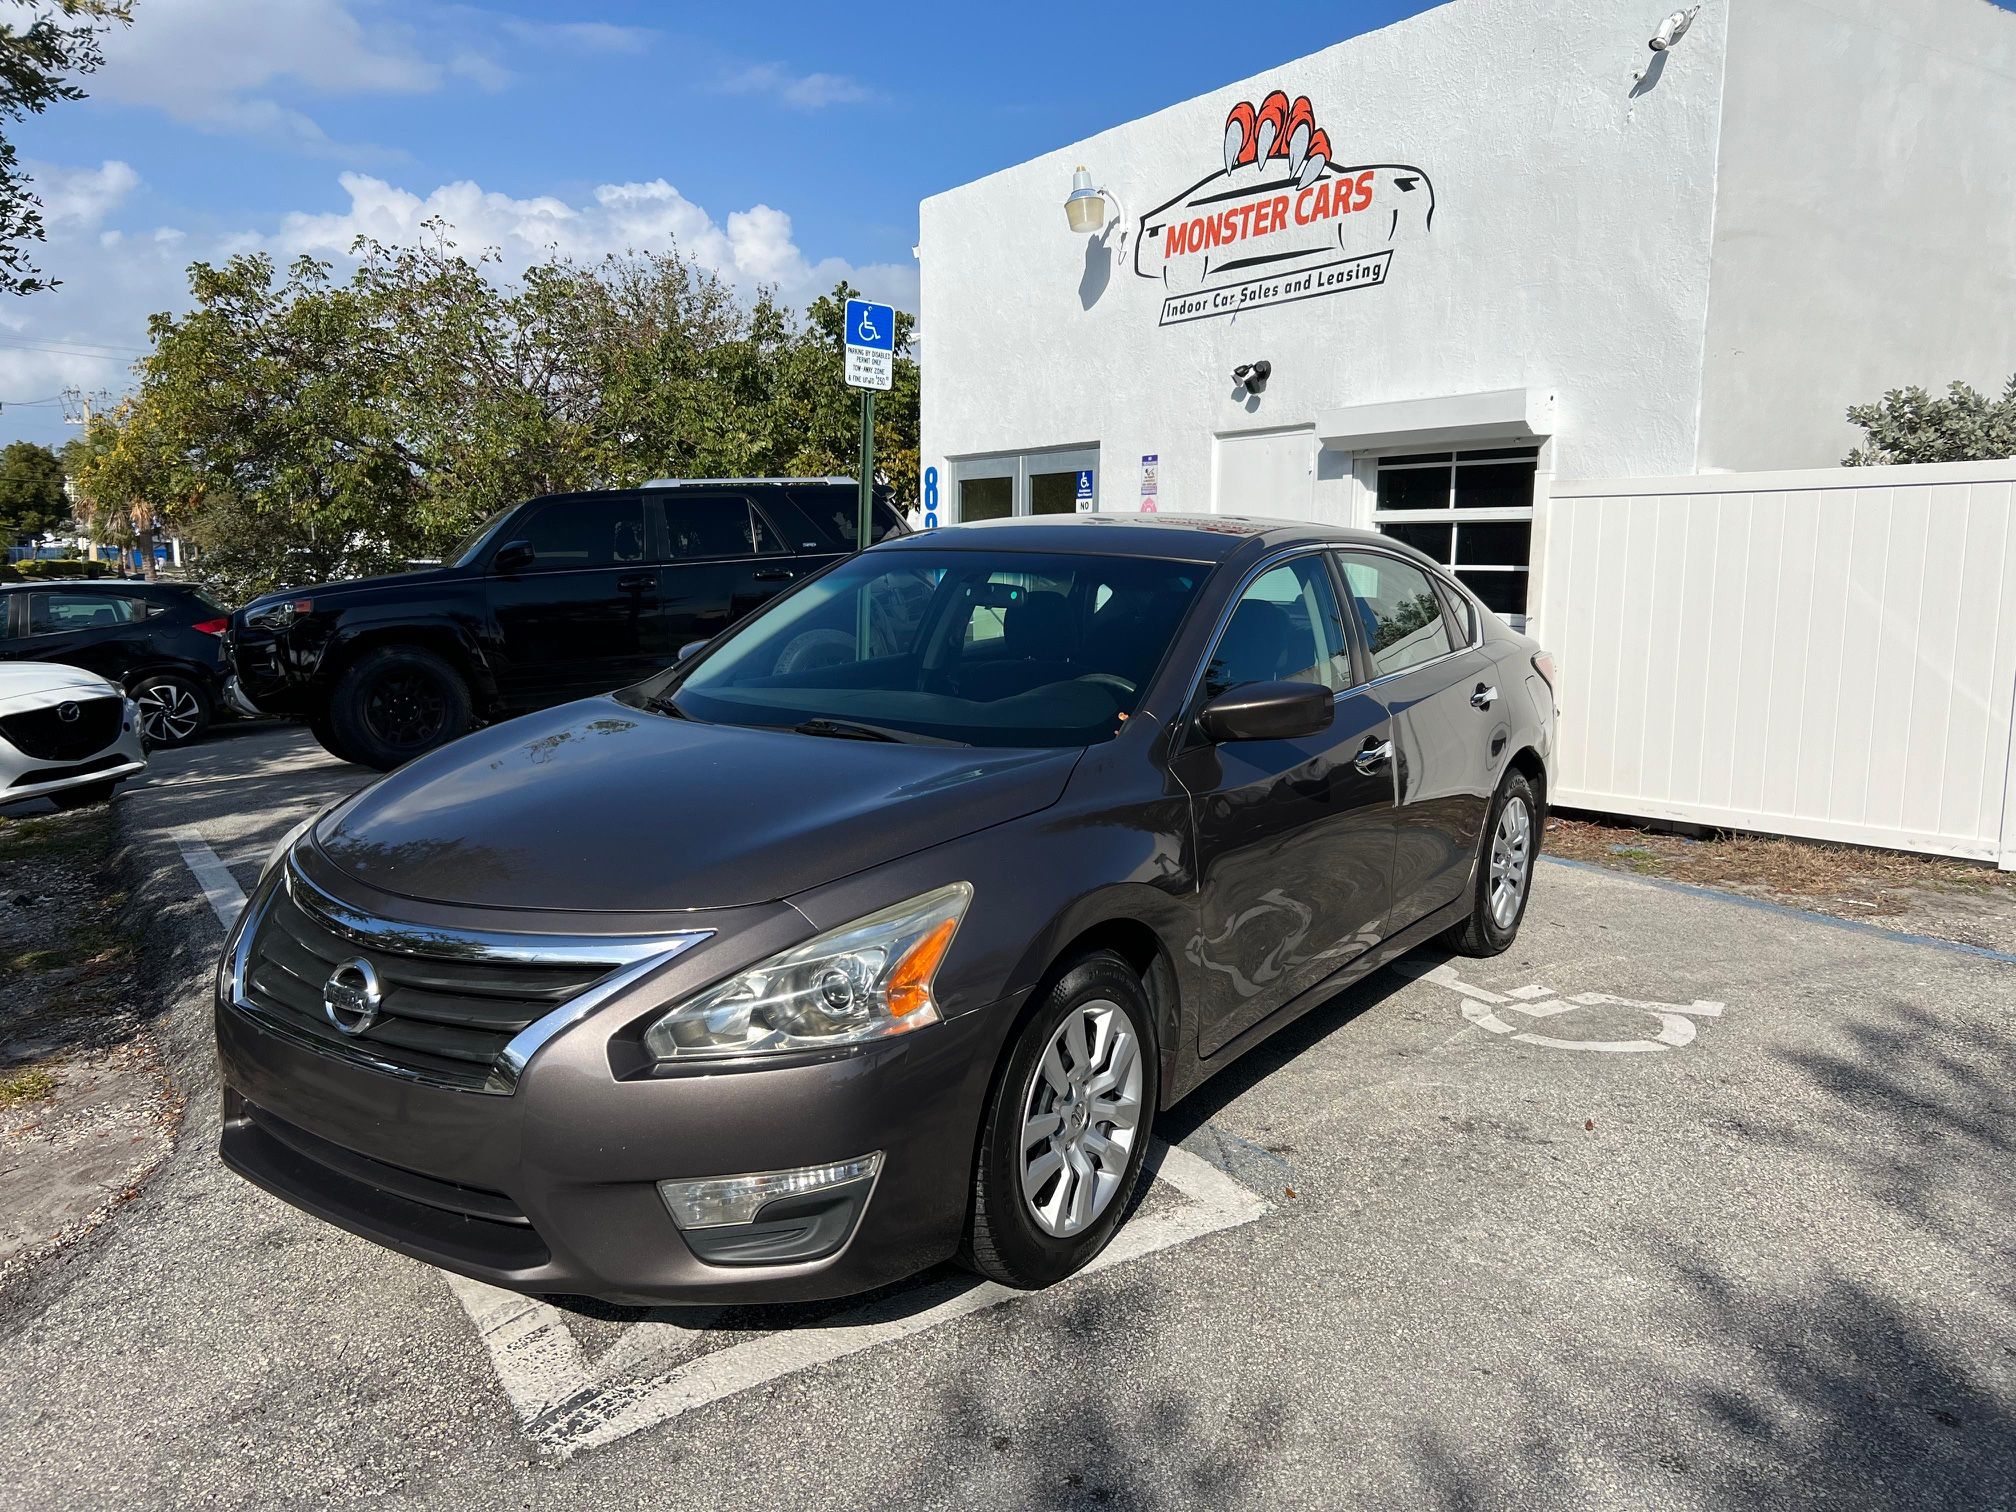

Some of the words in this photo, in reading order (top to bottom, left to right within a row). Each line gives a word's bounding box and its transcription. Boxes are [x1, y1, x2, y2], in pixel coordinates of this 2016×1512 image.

[1165, 195, 1290, 259] MONSTER
[1294, 170, 1375, 226] CARS
[1166, 299, 1208, 318] Indoor
[1213, 292, 1236, 309] Car
[1240, 283, 1279, 303] Sales
[1284, 273, 1312, 294] and
[1317, 262, 1382, 288] Leasing
[848, 347, 864, 356] PARKING
[872, 351, 890, 359] DISABLED
[1080, 501, 1090, 511] NO
